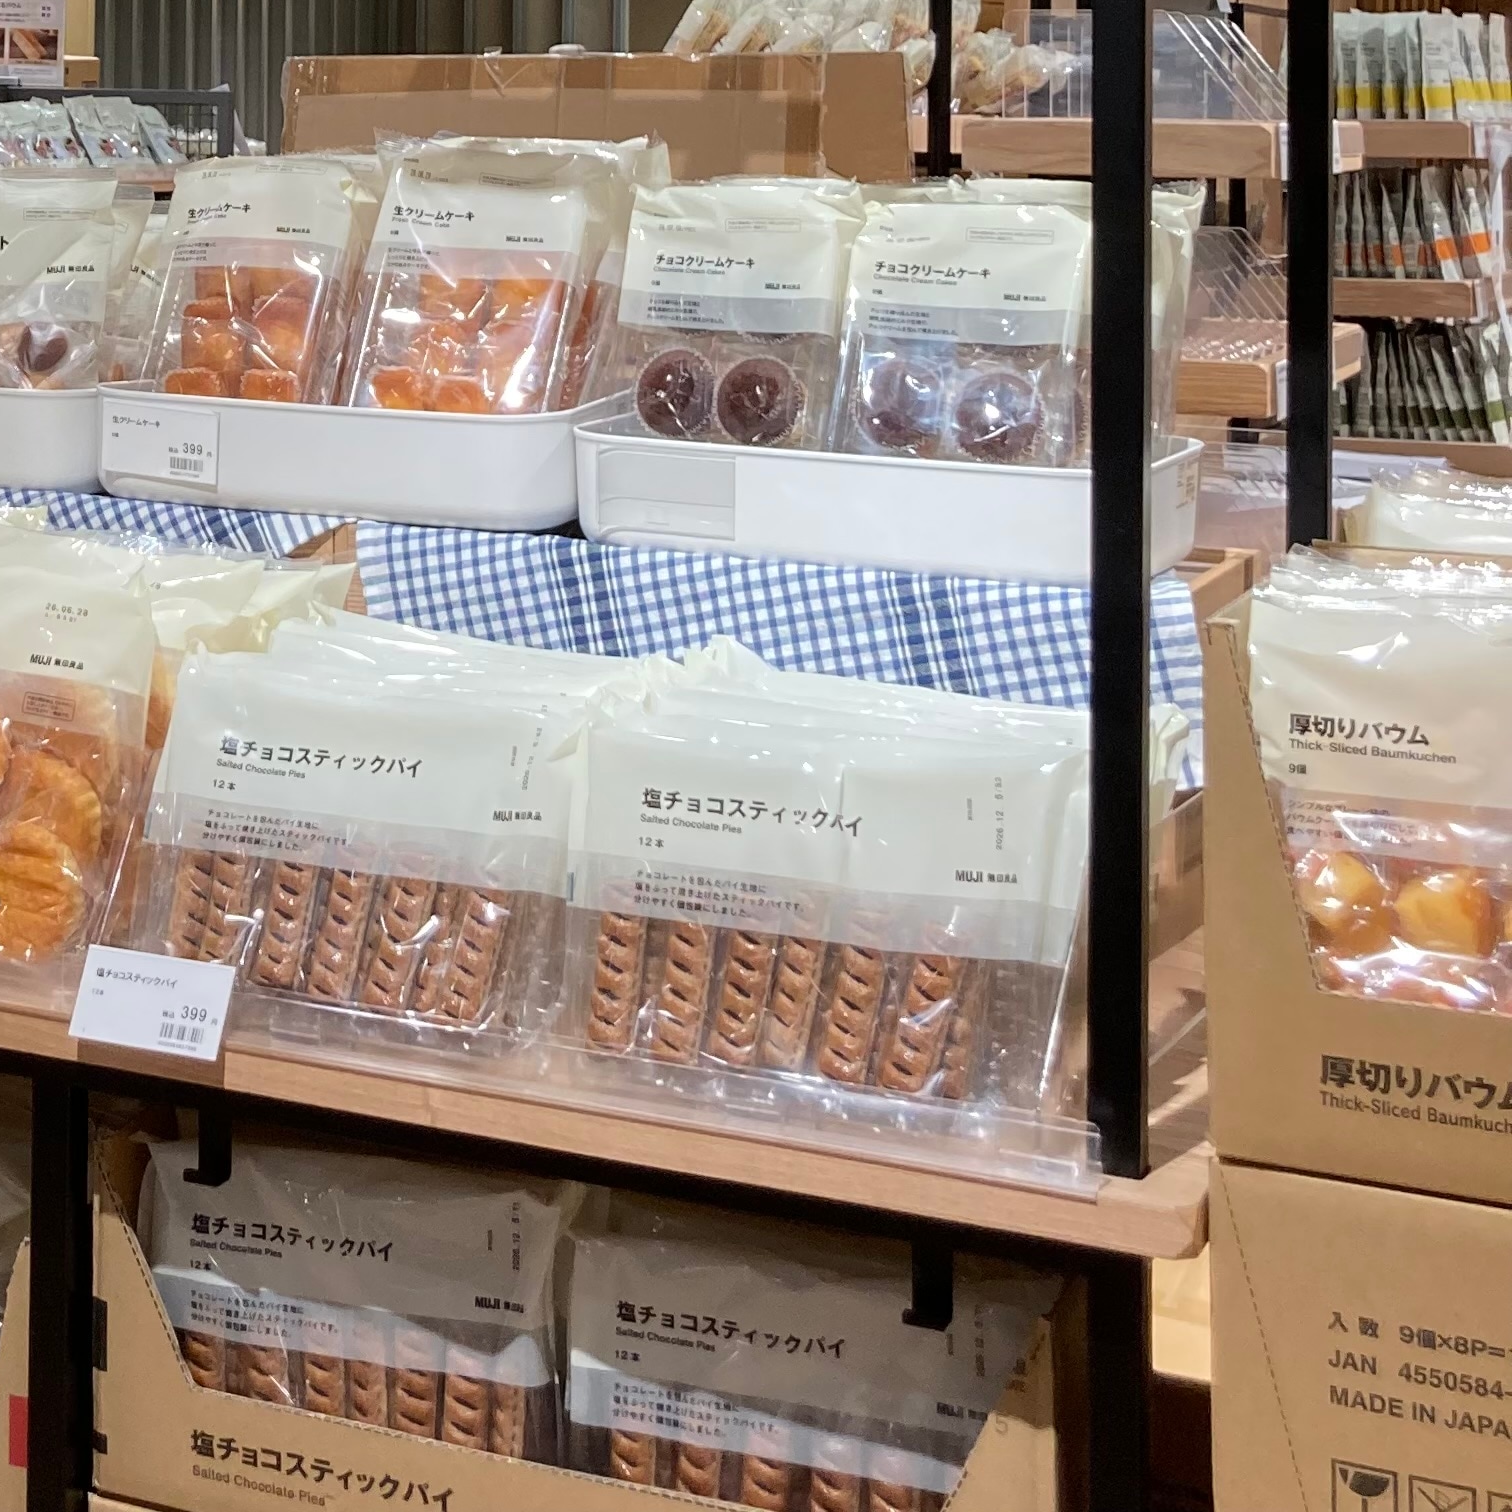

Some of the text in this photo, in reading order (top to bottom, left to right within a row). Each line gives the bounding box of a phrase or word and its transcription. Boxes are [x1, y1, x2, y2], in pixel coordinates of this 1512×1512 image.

[188, 202, 252, 219] 生クリームケーキ
[393, 205, 475, 222] 生クリームケーキ
[46, 266, 66, 275] MUJI
[656, 253, 755, 269] チョコクリームケーキ
[875, 261, 991, 279] チョコクリームケーキ
[112, 415, 161, 428] 生クリームケーキ
[182, 442, 203, 455] 399
[29, 654, 84, 670] MUJI 無印良品
[1289, 713, 1430, 746] 厚切りバウム
[219, 735, 424, 779] 塩チョコスティックパイ
[1371, 746, 1457, 764] Baumkuchen
[216, 757, 306, 780] Salted Chocolate Pies
[1288, 763, 1307, 775] 9個
[492, 810, 513, 822] MUJI
[642, 787, 863, 837] 塩チョコスティックパイ
[640, 813, 742, 834] Salted Chocolate Pies
[955, 869, 984, 883] MUJI
[96, 967, 178, 989] 塩チョコスティックパイ
[180, 1004, 208, 1023] 399
[1319, 1090, 1421, 1121] Thick-Sliced
[191, 1212, 394, 1261] 塩チョコスティックパイ
[189, 1238, 283, 1259] Salted Chocolate Pies
[474, 1295, 501, 1310] MUJI
[615, 1326, 716, 1352] Salted Chocolate Pies
[616, 1300, 846, 1359] 塩チョコスティックパイ
[1399, 1325, 1512, 1358] 9個×8P=
[1328, 1349, 1377, 1375] JAN
[1329, 1385, 1404, 1419] MADE
[1411, 1401, 1436, 1425] IN
[190, 1429, 455, 1511] 塩チョコスティックパイ
[192, 1463, 326, 1507] Salted Chocolate Pies
